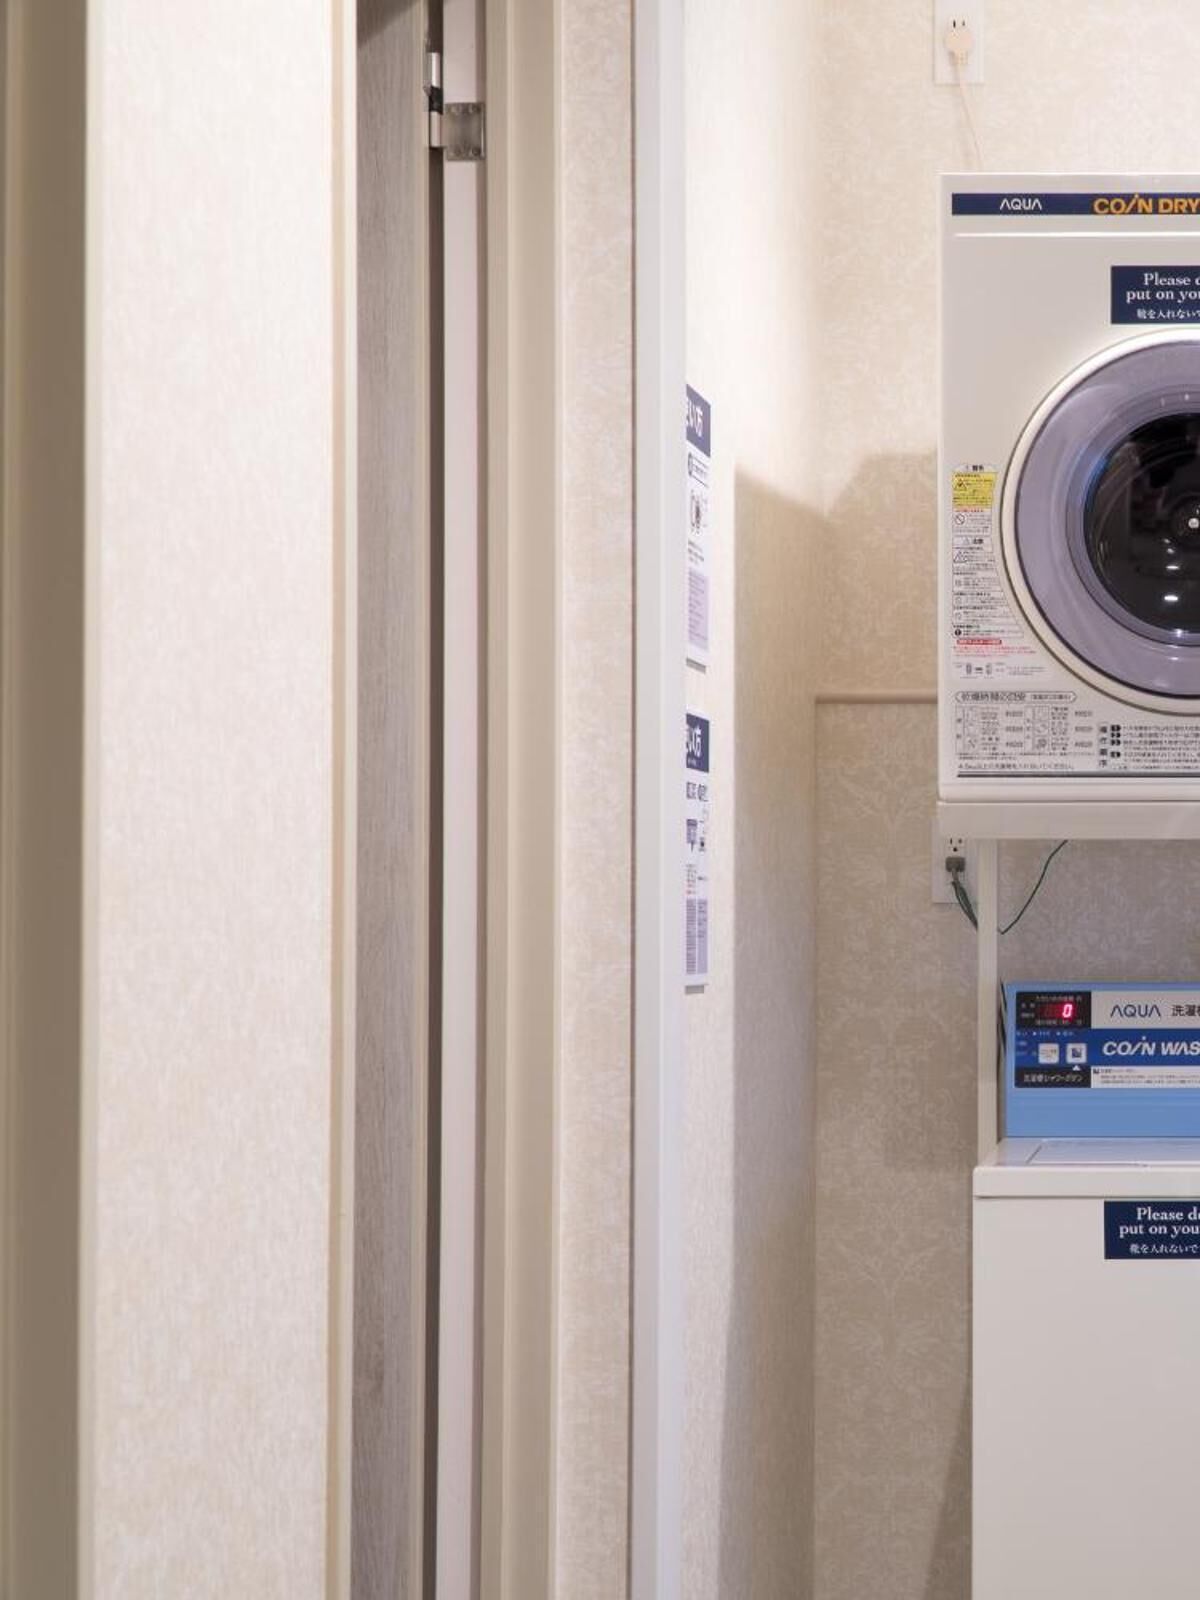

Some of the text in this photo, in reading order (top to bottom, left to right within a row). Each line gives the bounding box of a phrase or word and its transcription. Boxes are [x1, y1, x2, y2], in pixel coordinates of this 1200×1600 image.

[1000, 198, 1042, 211] AQUA
[1143, 272, 1191, 286] Please
[1126, 289, 1151, 304] put
[1156, 290, 1174, 300] on
[1062, 1003, 1074, 1018] 0
[1110, 1004, 1161, 1018] AQUA
[1136, 1206, 1184, 1221] Please
[1119, 1223, 1144, 1239] put
[1149, 1224, 1167, 1235] on
